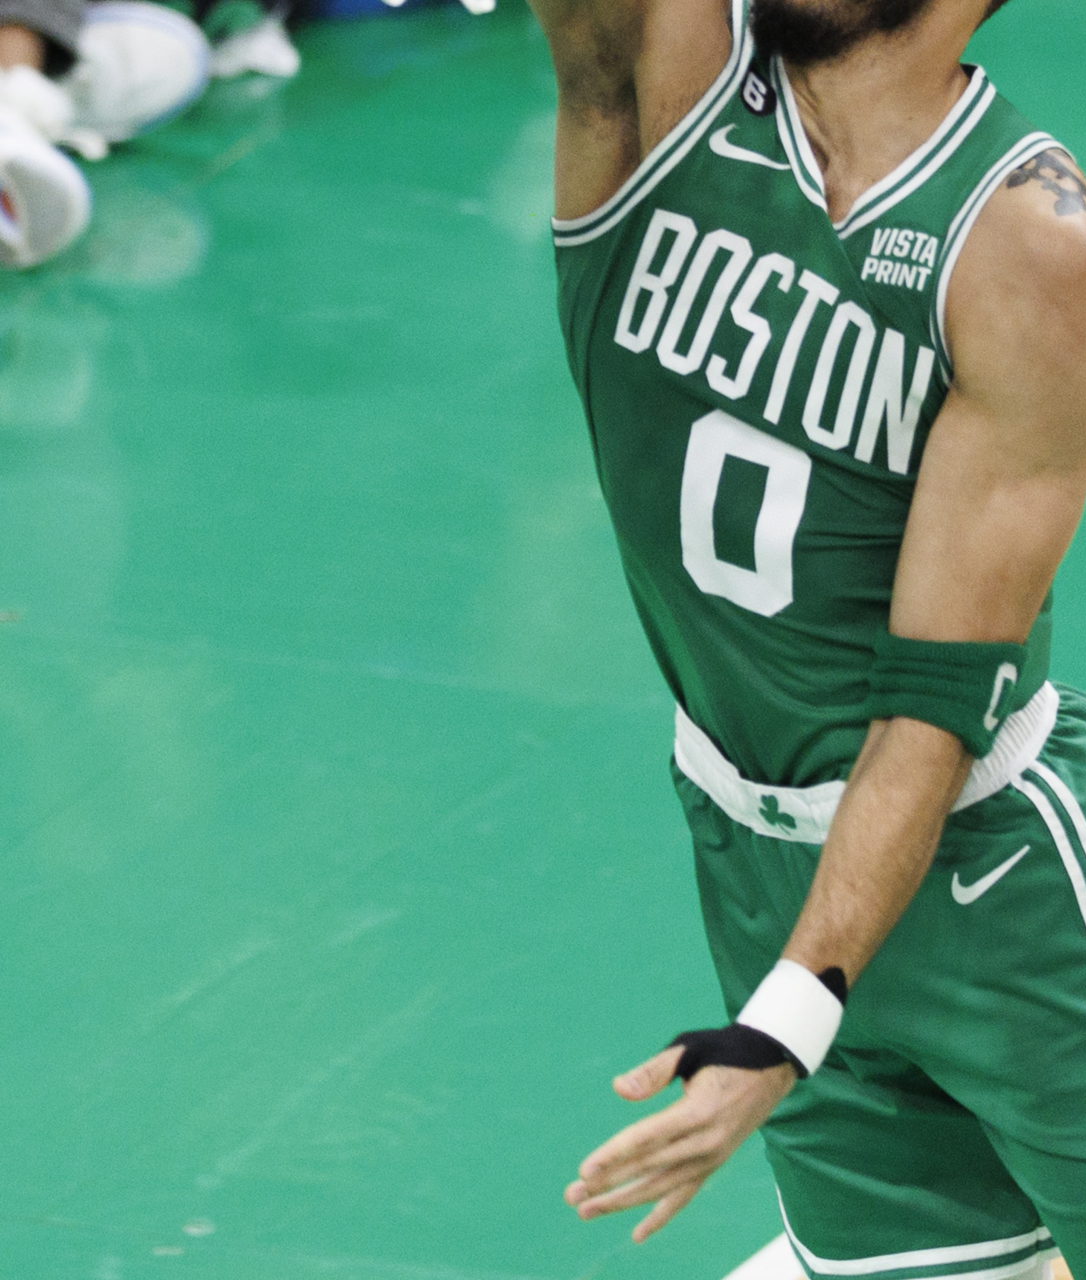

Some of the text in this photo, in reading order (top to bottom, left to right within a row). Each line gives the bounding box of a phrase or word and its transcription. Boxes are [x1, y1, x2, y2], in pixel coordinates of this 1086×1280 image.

[743, 71, 767, 111] 6
[870, 227, 938, 268] VISTA
[861, 256, 932, 291] PRINT
[613, 208, 936, 475] BOSTON
[679, 408, 812, 618] 0
